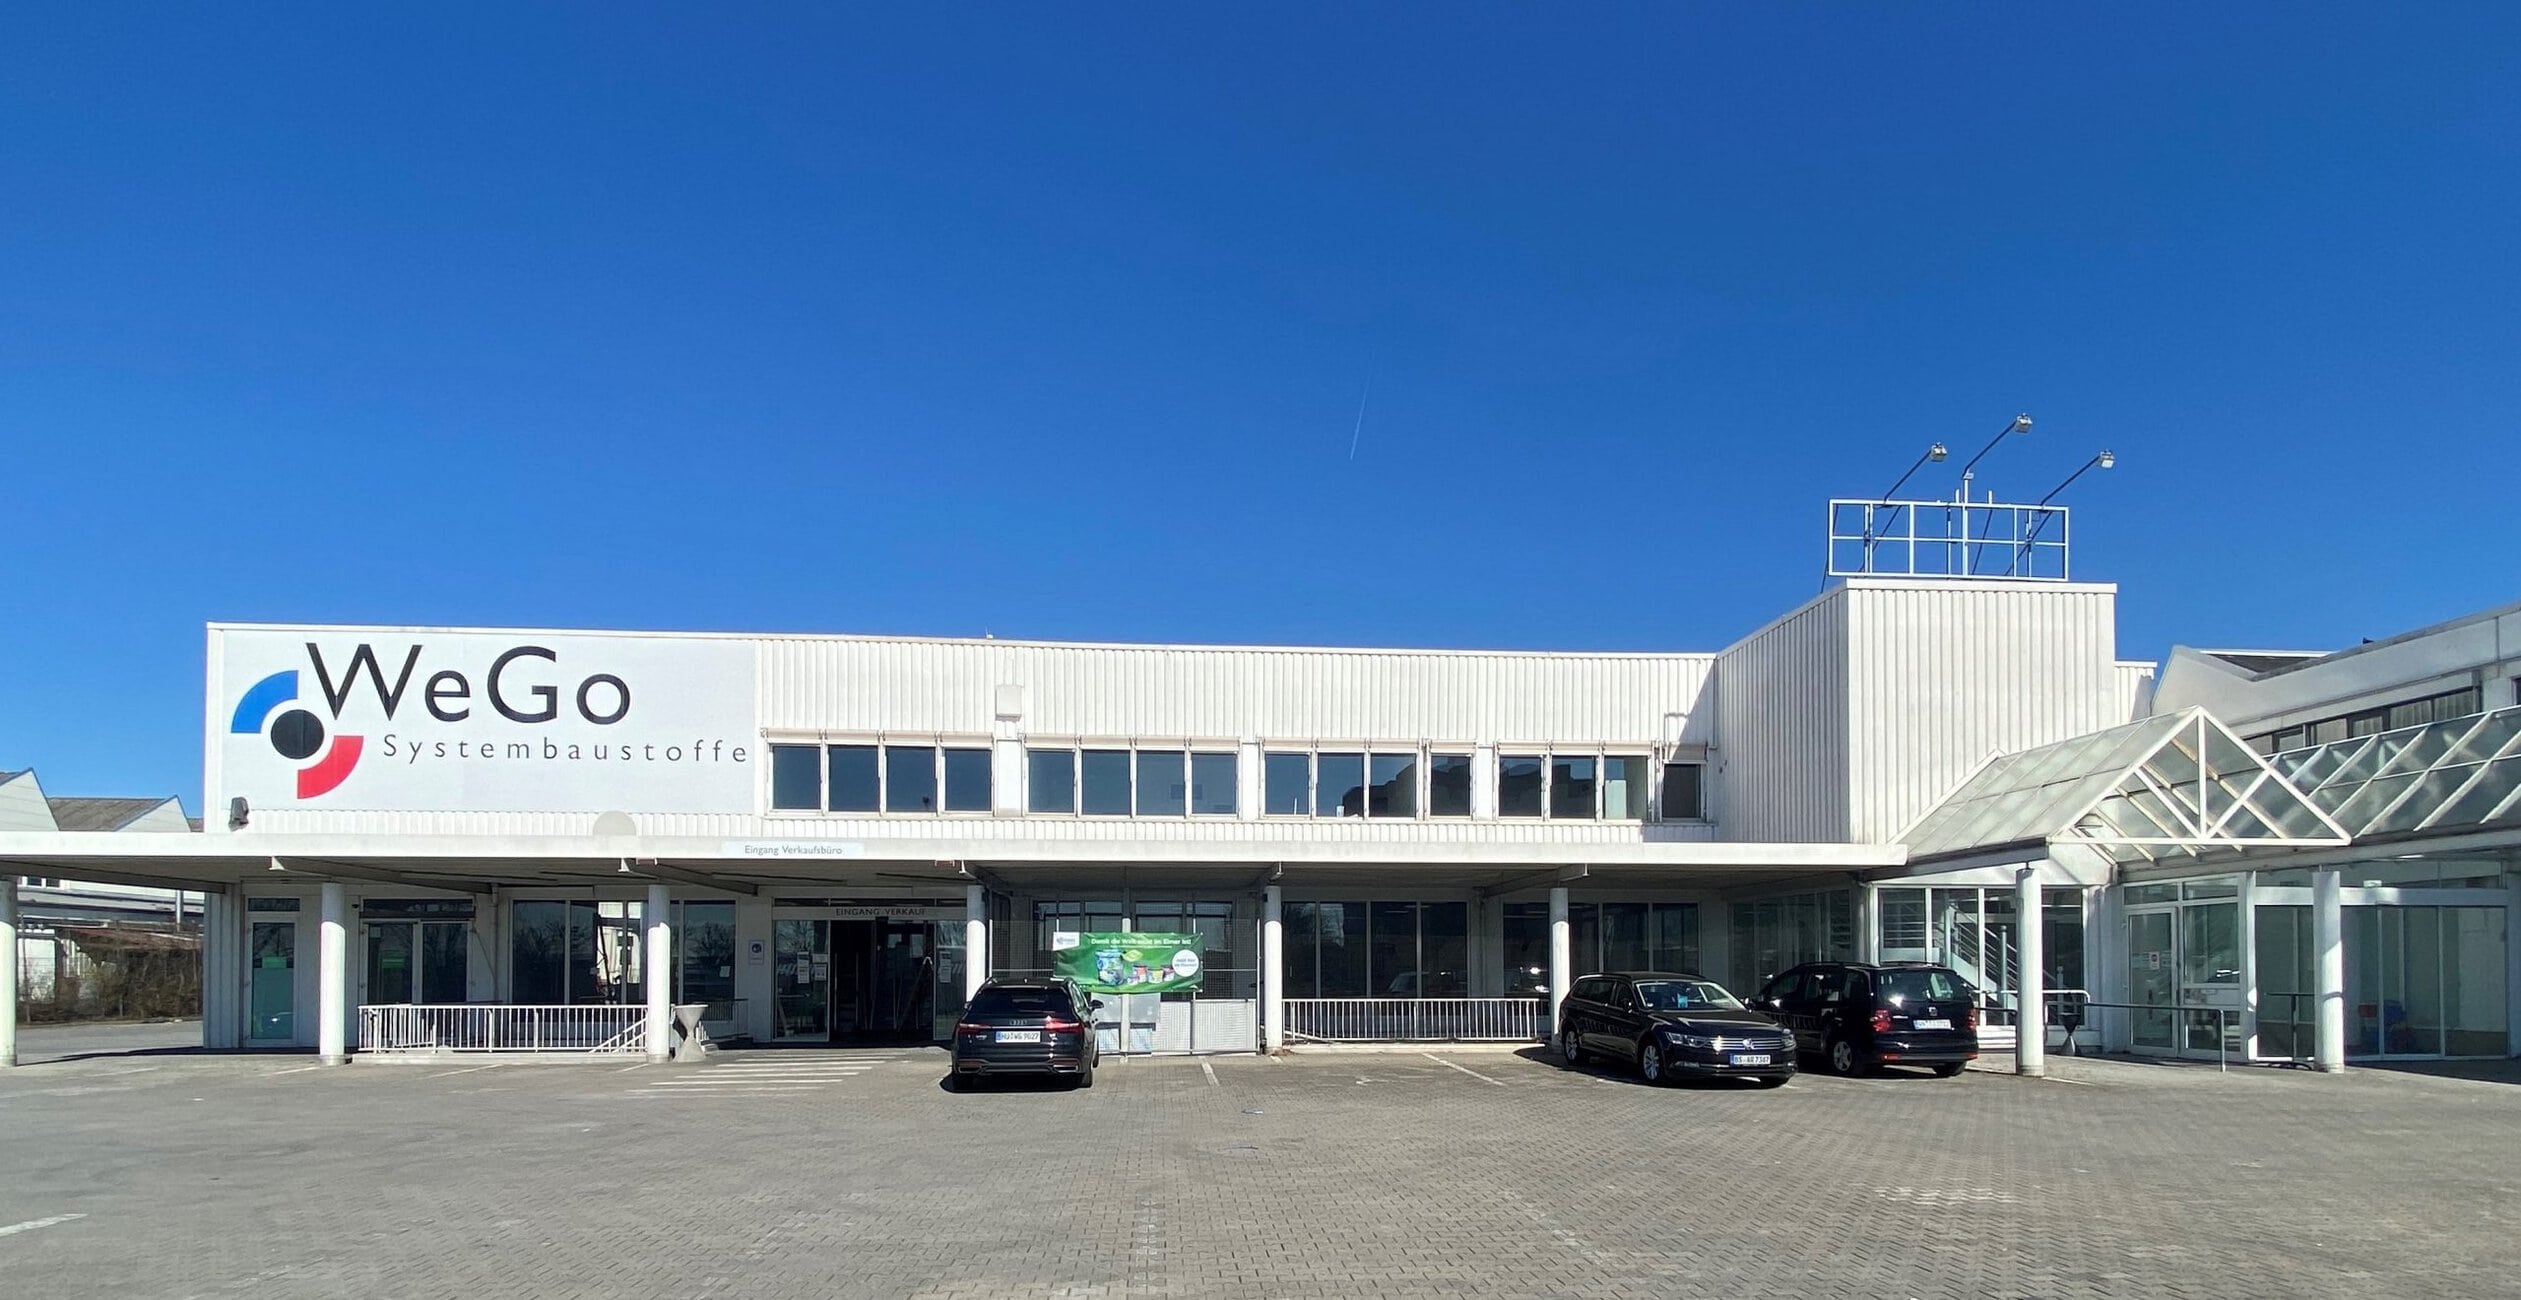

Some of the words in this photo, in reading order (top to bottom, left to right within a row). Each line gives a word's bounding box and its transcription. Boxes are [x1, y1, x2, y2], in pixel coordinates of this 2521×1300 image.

[306, 643, 631, 725] WeGo
[383, 733, 747, 764] Systembaustoffe
[744, 845, 779, 856] Eingang
[782, 845, 843, 855] Verkaufsbüro
[836, 908, 880, 916] EINGANG
[884, 908, 925, 916] VERKAUF
